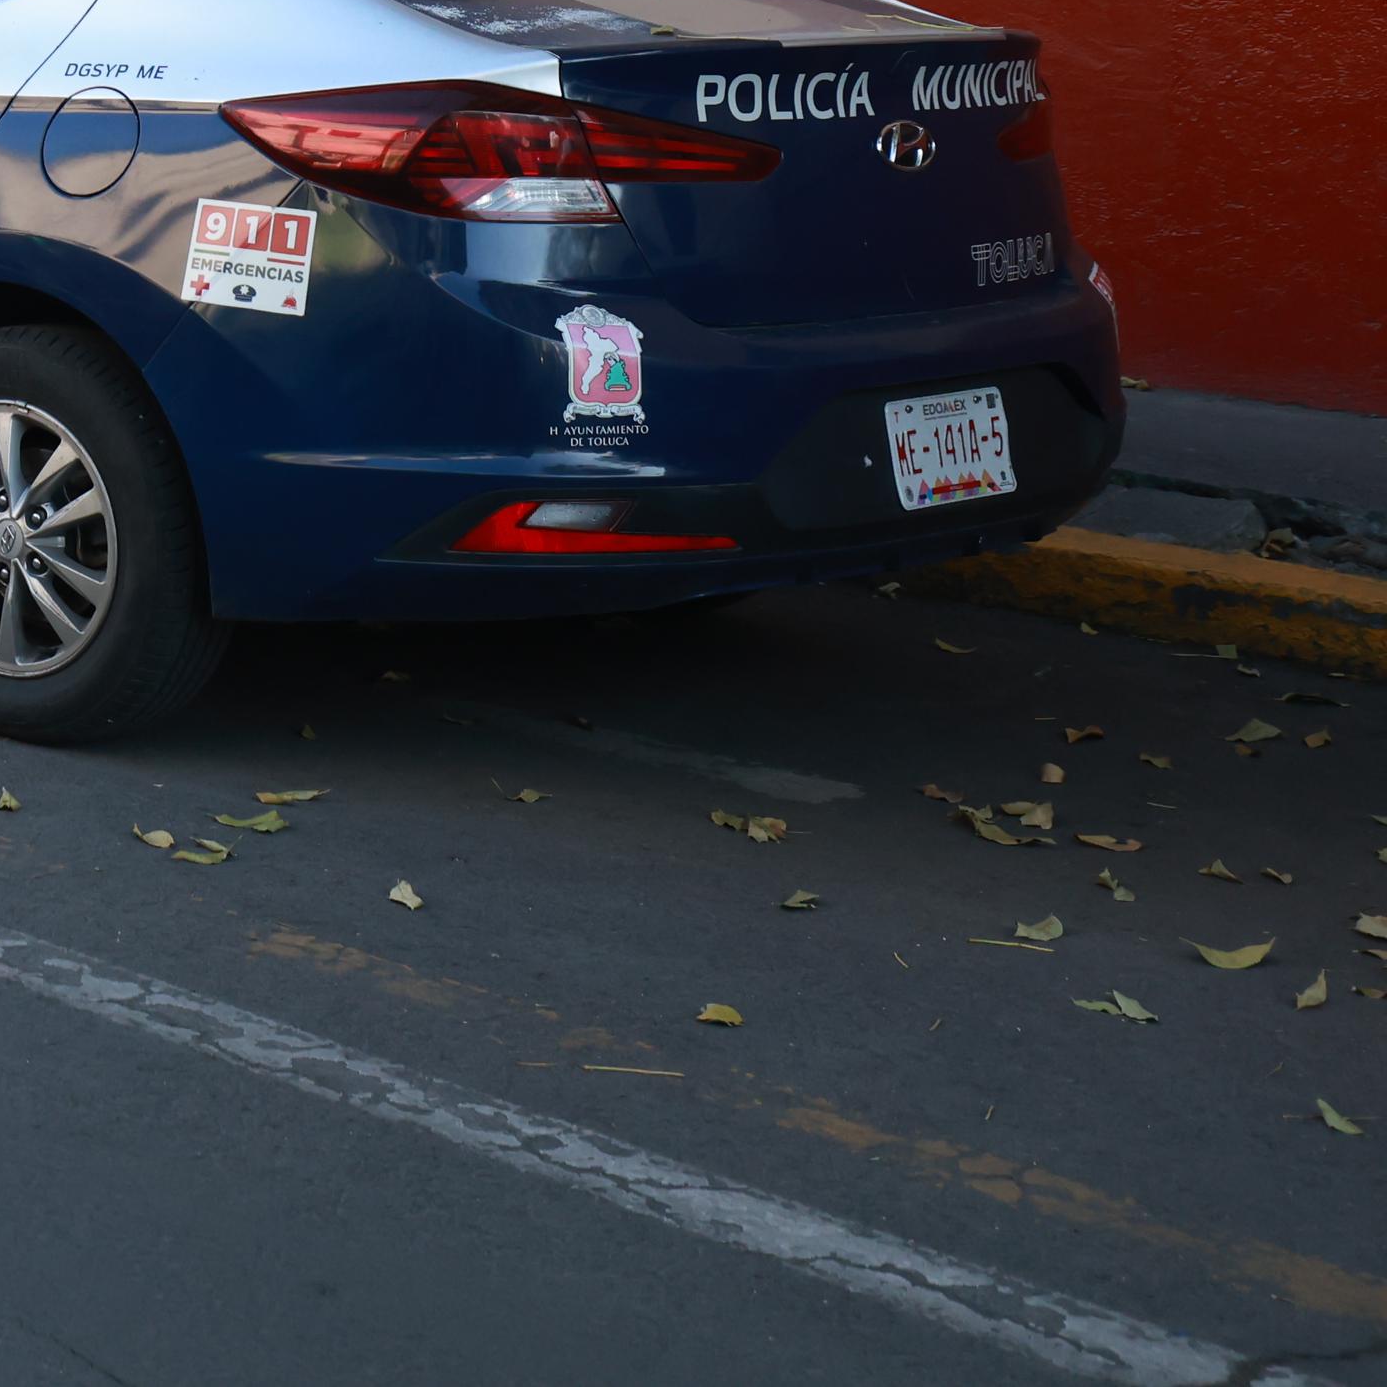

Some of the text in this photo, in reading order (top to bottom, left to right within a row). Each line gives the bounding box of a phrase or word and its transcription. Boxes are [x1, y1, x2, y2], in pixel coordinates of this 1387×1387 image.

[64, 62, 168, 80] DGSYP ME
[696, 58, 1046, 122] POLICÍA MUNICIPAL
[204, 211, 298, 250] 911
[190, 257, 304, 284] EMERGENCIAS
[970, 232, 1055, 286] TOLUCA
[564, 424, 650, 435] AYUNTAMIENTO
[587, 436, 630, 447] TOLUCA
[895, 416, 1003, 477] ME-141A-5
